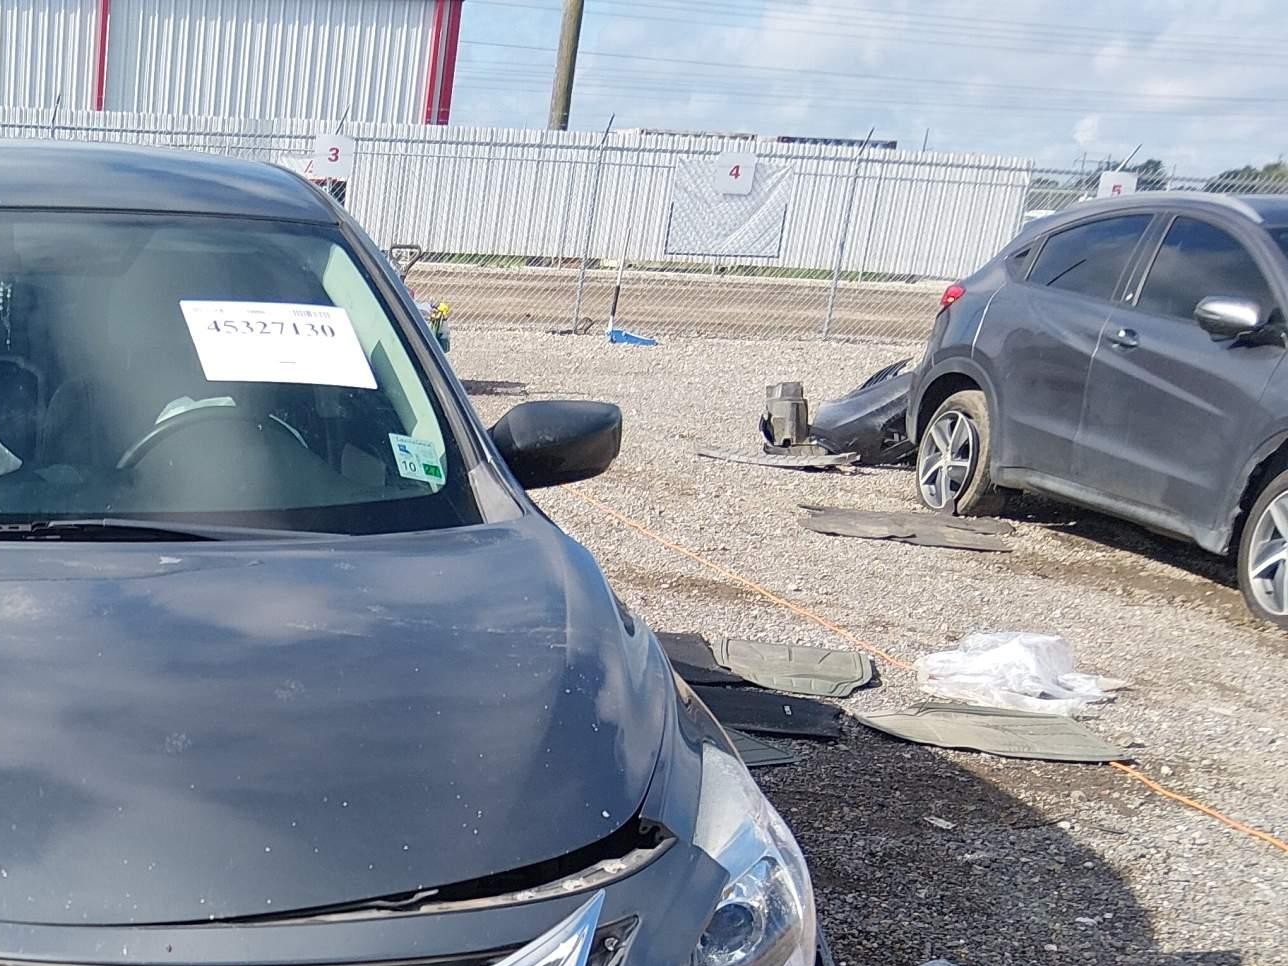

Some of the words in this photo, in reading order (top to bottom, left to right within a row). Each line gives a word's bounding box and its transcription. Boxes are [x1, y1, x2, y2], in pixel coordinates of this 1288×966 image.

[327, 147, 340, 162] 3
[728, 164, 740, 179] 4
[208, 320, 336, 337] 45327130
[401, 460, 416, 472] 10
